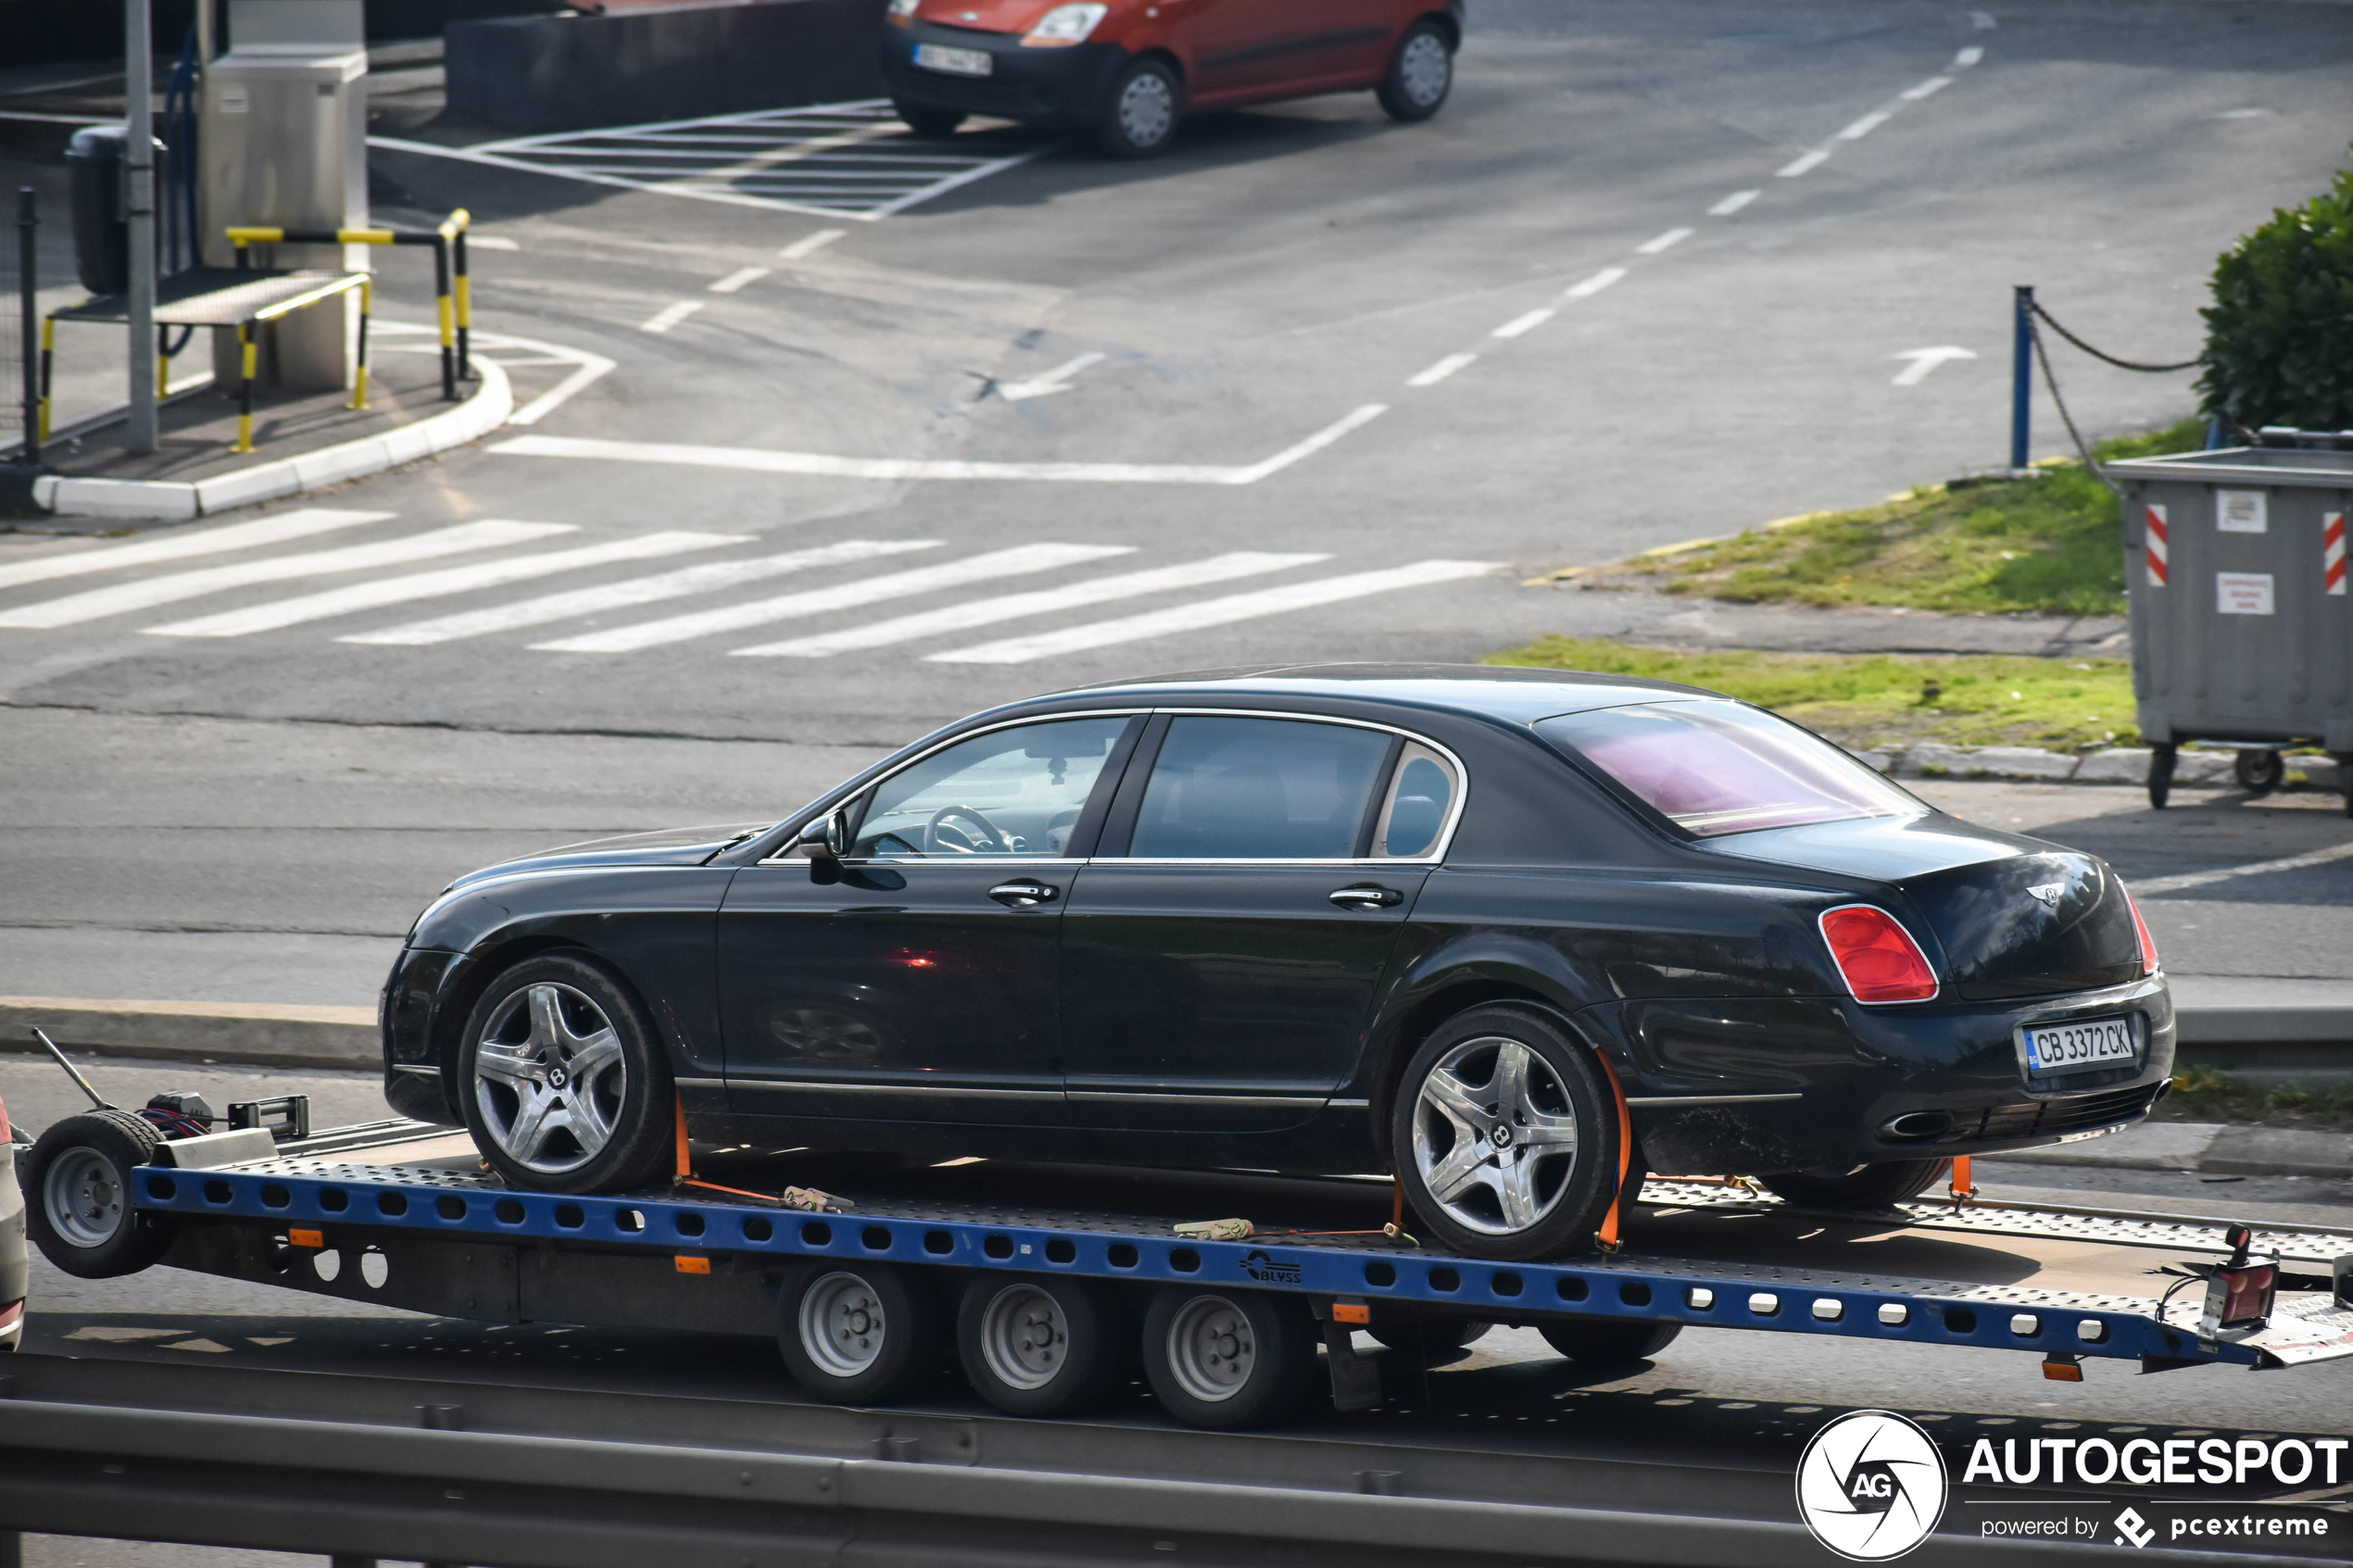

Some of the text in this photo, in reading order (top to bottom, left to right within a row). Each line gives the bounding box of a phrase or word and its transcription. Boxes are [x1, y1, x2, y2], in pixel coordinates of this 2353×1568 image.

[2037, 1024, 2129, 1062] CB 3372 CK
[2029, 1055, 2038, 1064] BG
[549, 1068, 566, 1086] B
[1493, 1125, 1510, 1146] B
[1261, 1271, 1301, 1284] BLYSS
